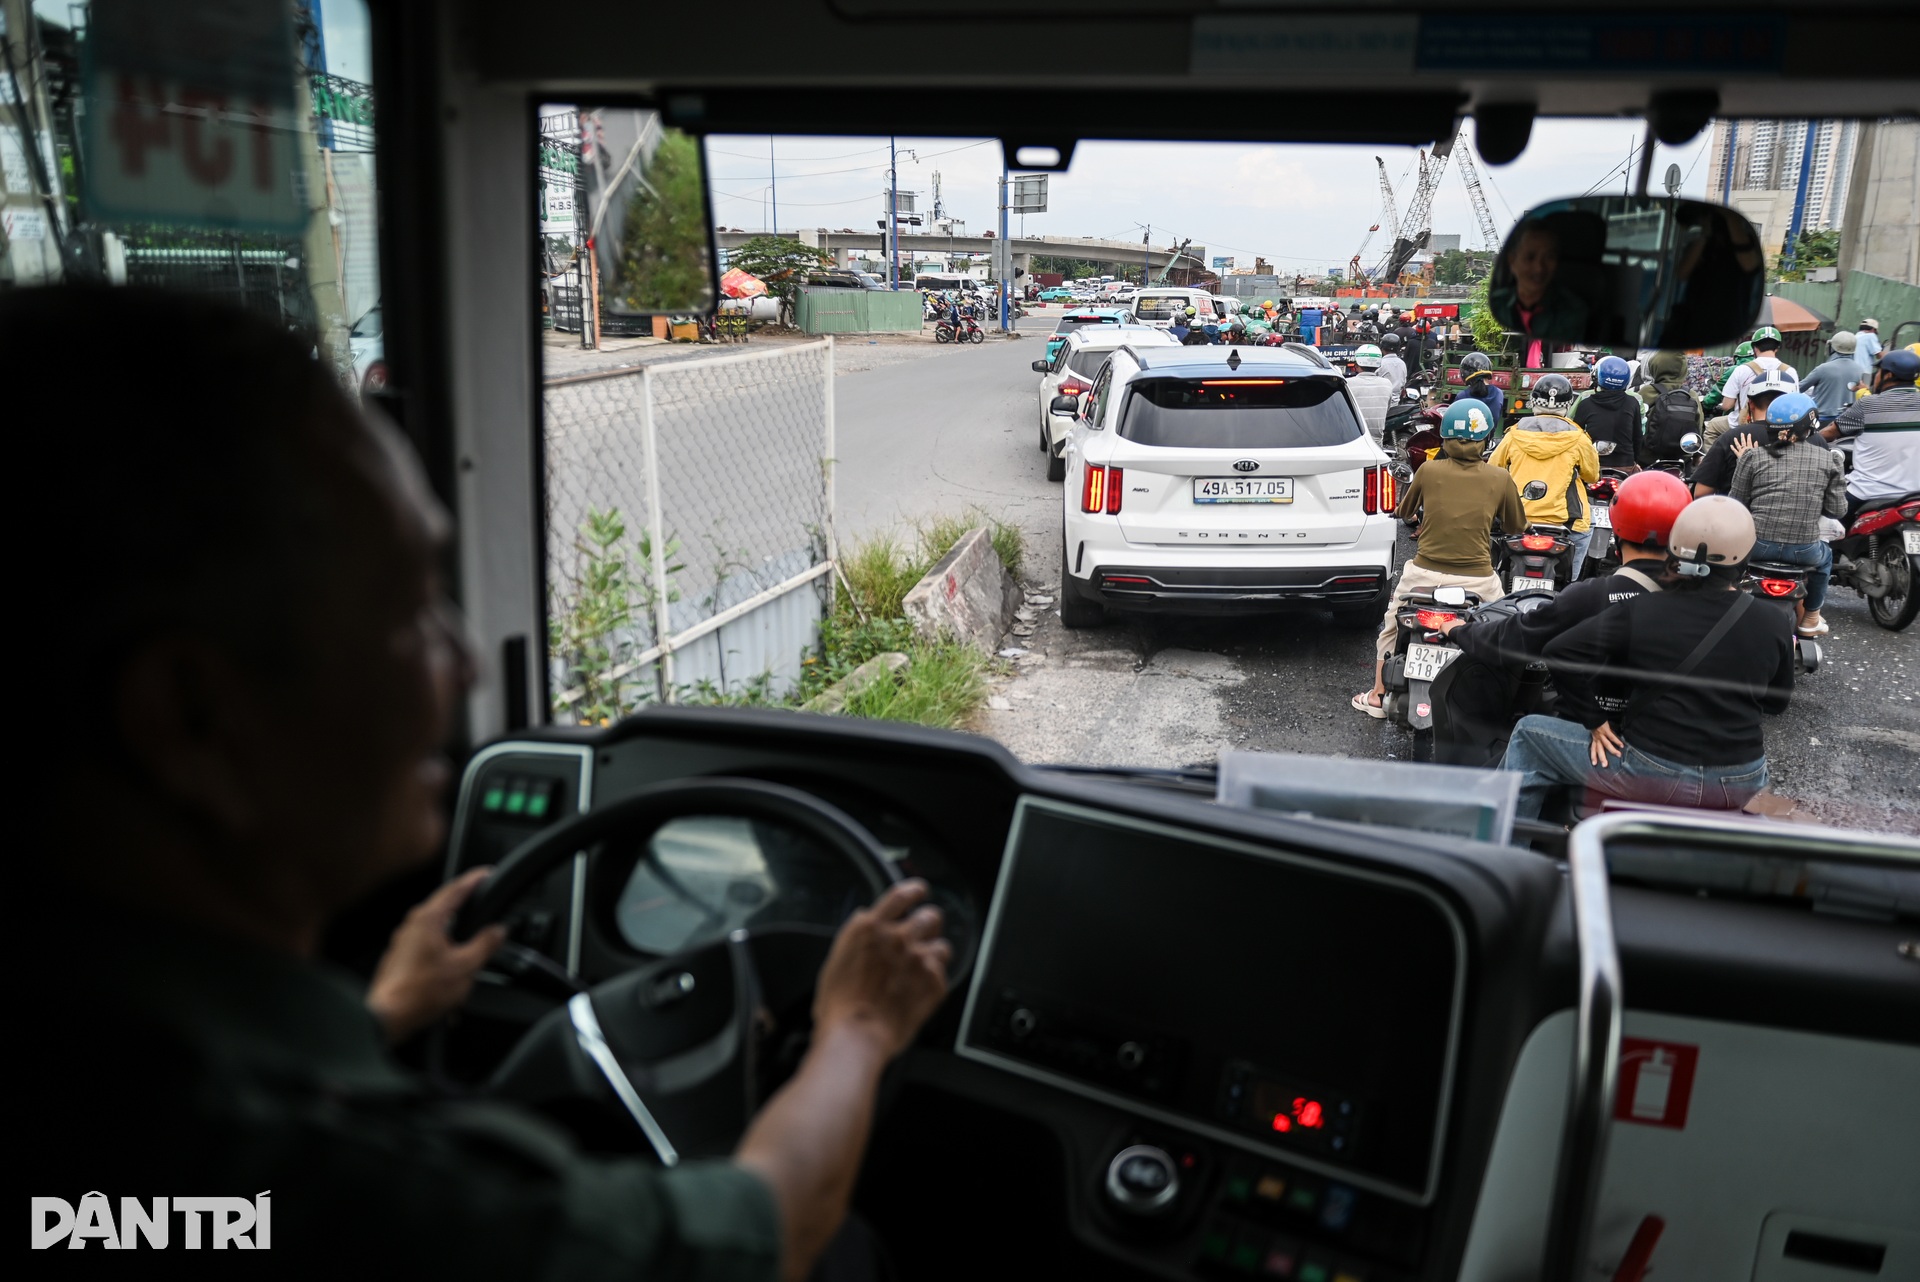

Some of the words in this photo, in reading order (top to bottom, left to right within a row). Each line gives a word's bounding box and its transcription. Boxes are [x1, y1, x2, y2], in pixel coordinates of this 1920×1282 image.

[1237, 462, 1256, 471] KIA
[1202, 482, 1286, 495] 49A-517.05
[1608, 591, 1640, 601] BEYO
[1414, 647, 1449, 664] 92-N1
[1407, 661, 1442, 678] 518.
